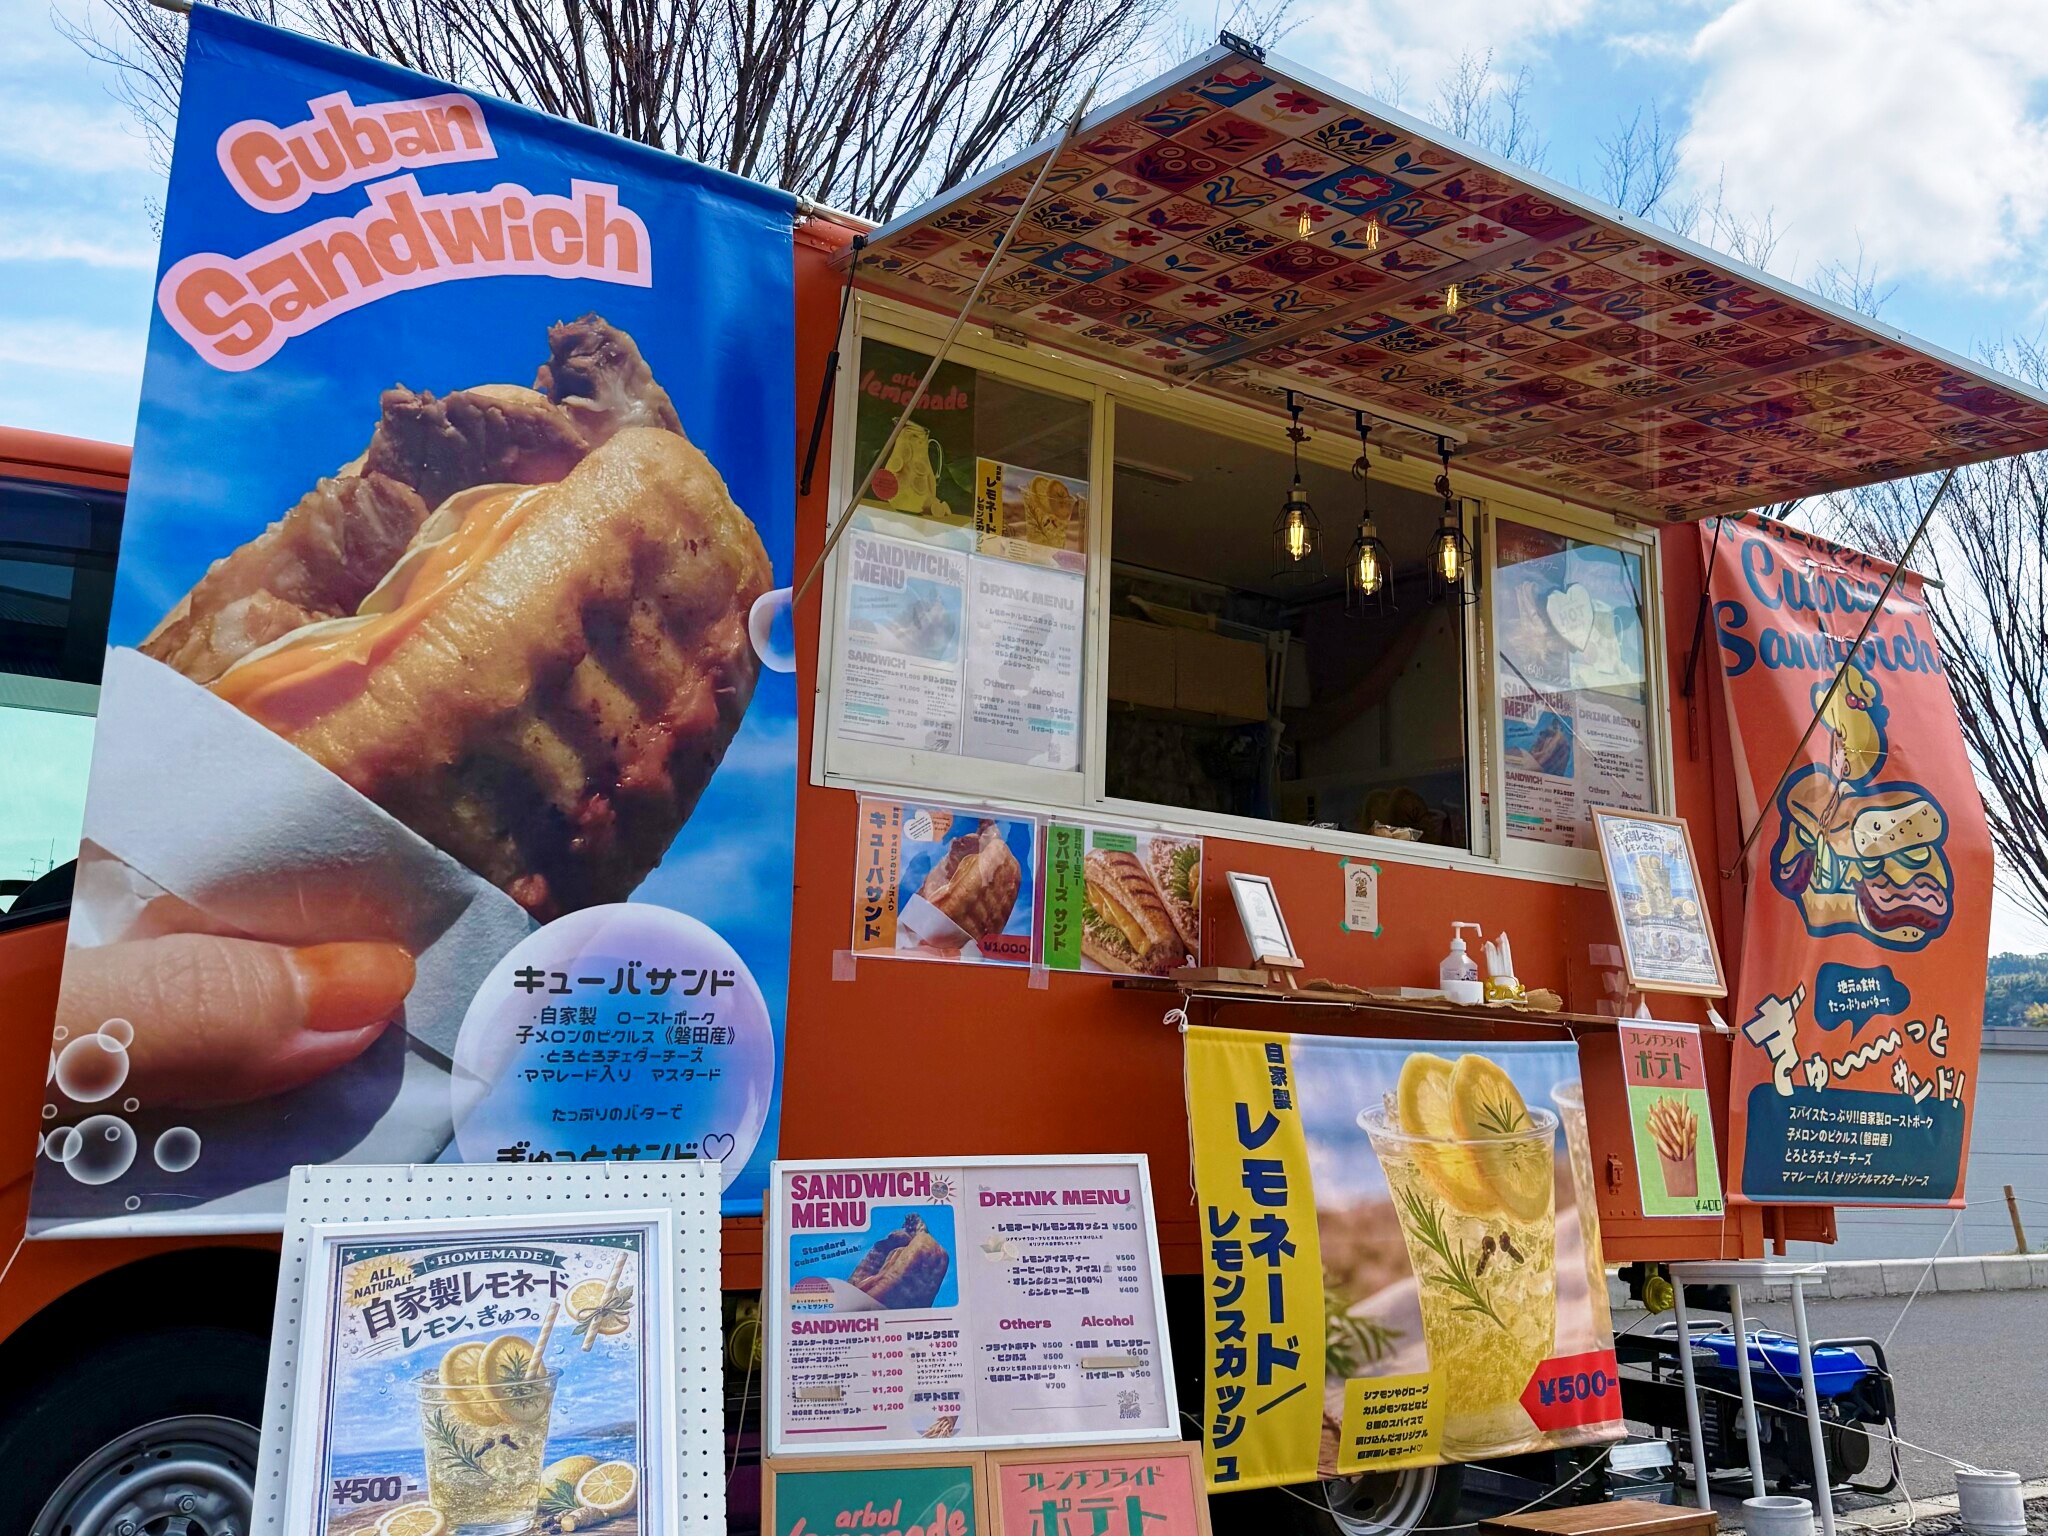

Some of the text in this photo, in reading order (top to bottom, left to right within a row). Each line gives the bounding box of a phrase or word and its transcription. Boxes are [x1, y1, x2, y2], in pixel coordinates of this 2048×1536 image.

[229, 104, 484, 202] Cuban
[175, 191, 639, 357] Sandwich
[855, 539, 949, 578] SANDWICH
[854, 560, 905, 589] MENU
[980, 582, 1074, 610] DRINK MENU
[1559, 605, 1585, 624] HOT
[848, 649, 906, 669] SANDWICH
[1032, 687, 1064, 699] Alcohol
[1505, 701, 1536, 720] MENU
[1579, 710, 1640, 728] DRINK MENU
[1506, 771, 1542, 784] SANDWICH
[864, 812, 886, 941] キューバサンド
[514, 961, 735, 996] キューバサンド
[617, 1010, 715, 1025] ローストポーク
[1629, 1032, 1688, 1049] フレンチフライド
[1634, 1051, 1691, 1080] ポテト
[652, 1068, 721, 1081] マスタード
[553, 1105, 683, 1122] たっぷりのバターで
[1785, 1148, 1873, 1166] とろとろチェダーチーズ
[791, 1172, 930, 1200] SANDWICH
[979, 1190, 1130, 1207] DRINK MENU
[1694, 1199, 1722, 1212] ¥400
[791, 1201, 866, 1228] MENU
[802, 1239, 846, 1255] Standard
[436, 1249, 544, 1266] HOMEMADE
[794, 1257, 820, 1267] Cuban
[369, 1266, 395, 1283] ALL
[354, 1274, 412, 1299] NATURAL!
[361, 1271, 570, 1338] 自家製レモネード
[792, 1318, 878, 1334] SANDWICH
[1000, 1318, 1051, 1330] Others
[1081, 1315, 1134, 1327] Alcohol
[907, 1330, 959, 1340] ドリンクSET
[1127, 1348, 1148, 1356] ¥600
[1208, 1206, 1247, 1483] レモンスカッシュ
[872, 1351, 903, 1359] ¥1,000
[872, 1369, 902, 1377] ¥1,200
[1131, 1370, 1150, 1378] ¥500
[914, 1392, 959, 1401] ポテトSET
[873, 1403, 904, 1411] ¥1,200
[1018, 1465, 1165, 1492] フレンチフライド
[836, 1498, 902, 1528] arbol
